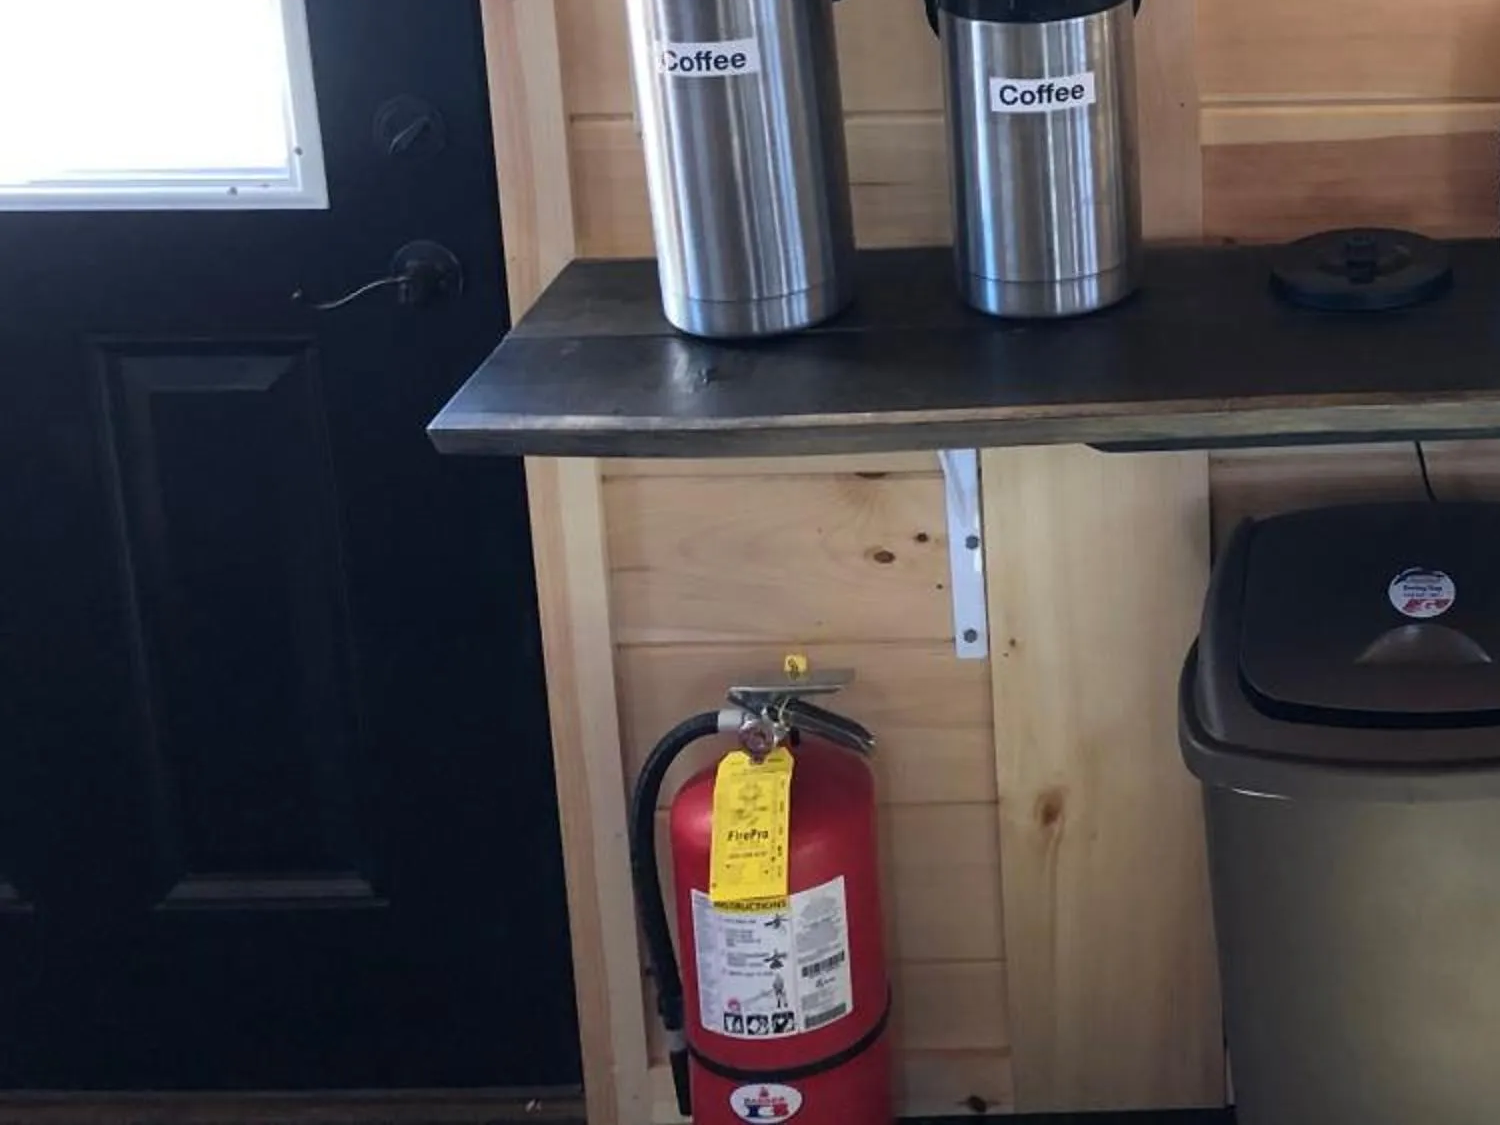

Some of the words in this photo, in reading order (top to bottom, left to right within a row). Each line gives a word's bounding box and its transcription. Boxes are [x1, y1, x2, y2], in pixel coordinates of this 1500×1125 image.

[662, 50, 747, 73] Coffee
[999, 83, 1085, 106] Coffee
[727, 828, 769, 842] FirePro
